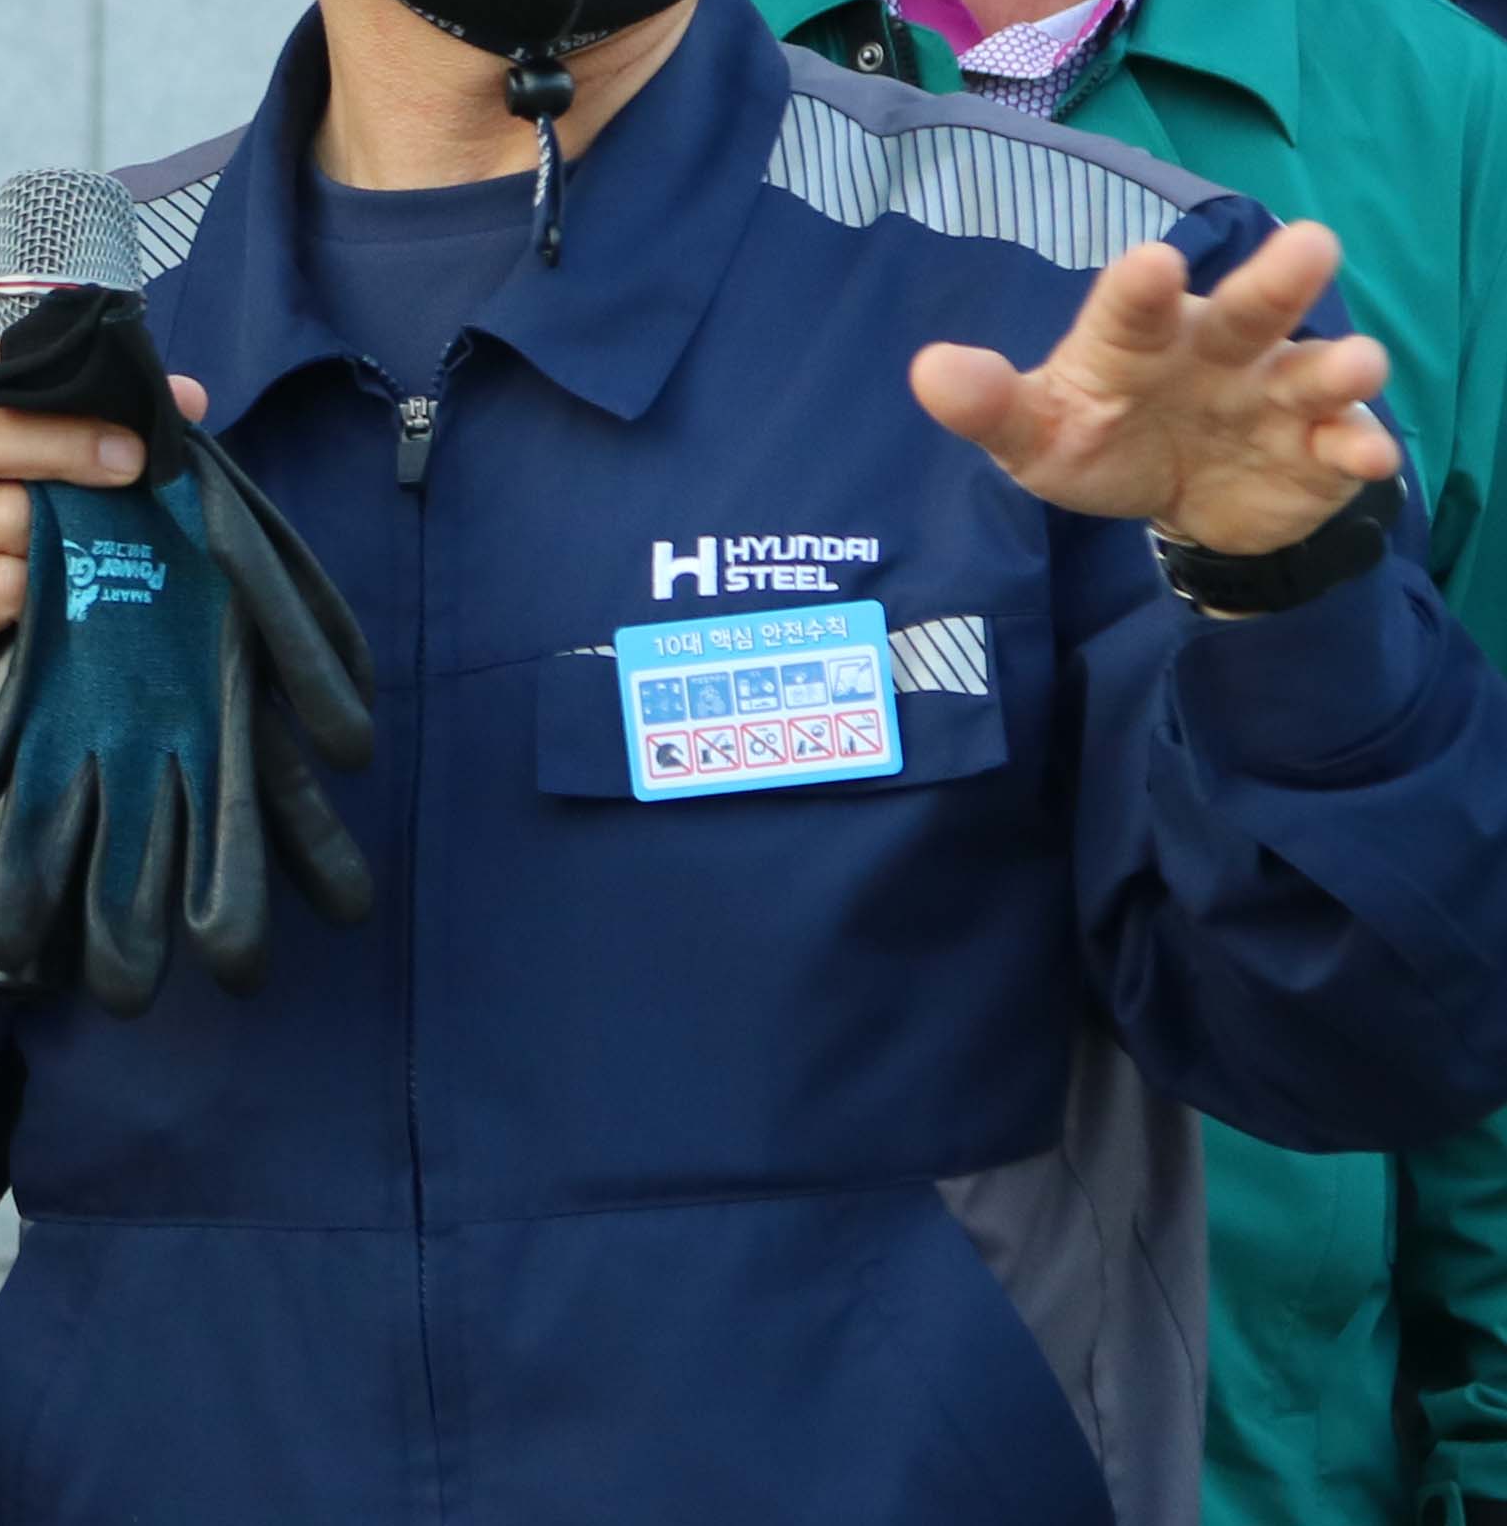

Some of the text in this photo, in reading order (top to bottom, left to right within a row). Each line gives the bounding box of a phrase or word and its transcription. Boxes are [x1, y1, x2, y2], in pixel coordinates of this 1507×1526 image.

[724, 534, 880, 563] HYUNDAI
[724, 564, 840, 592] STEEL
[653, 631, 704, 657] 10대
[709, 626, 754, 651] 핵심
